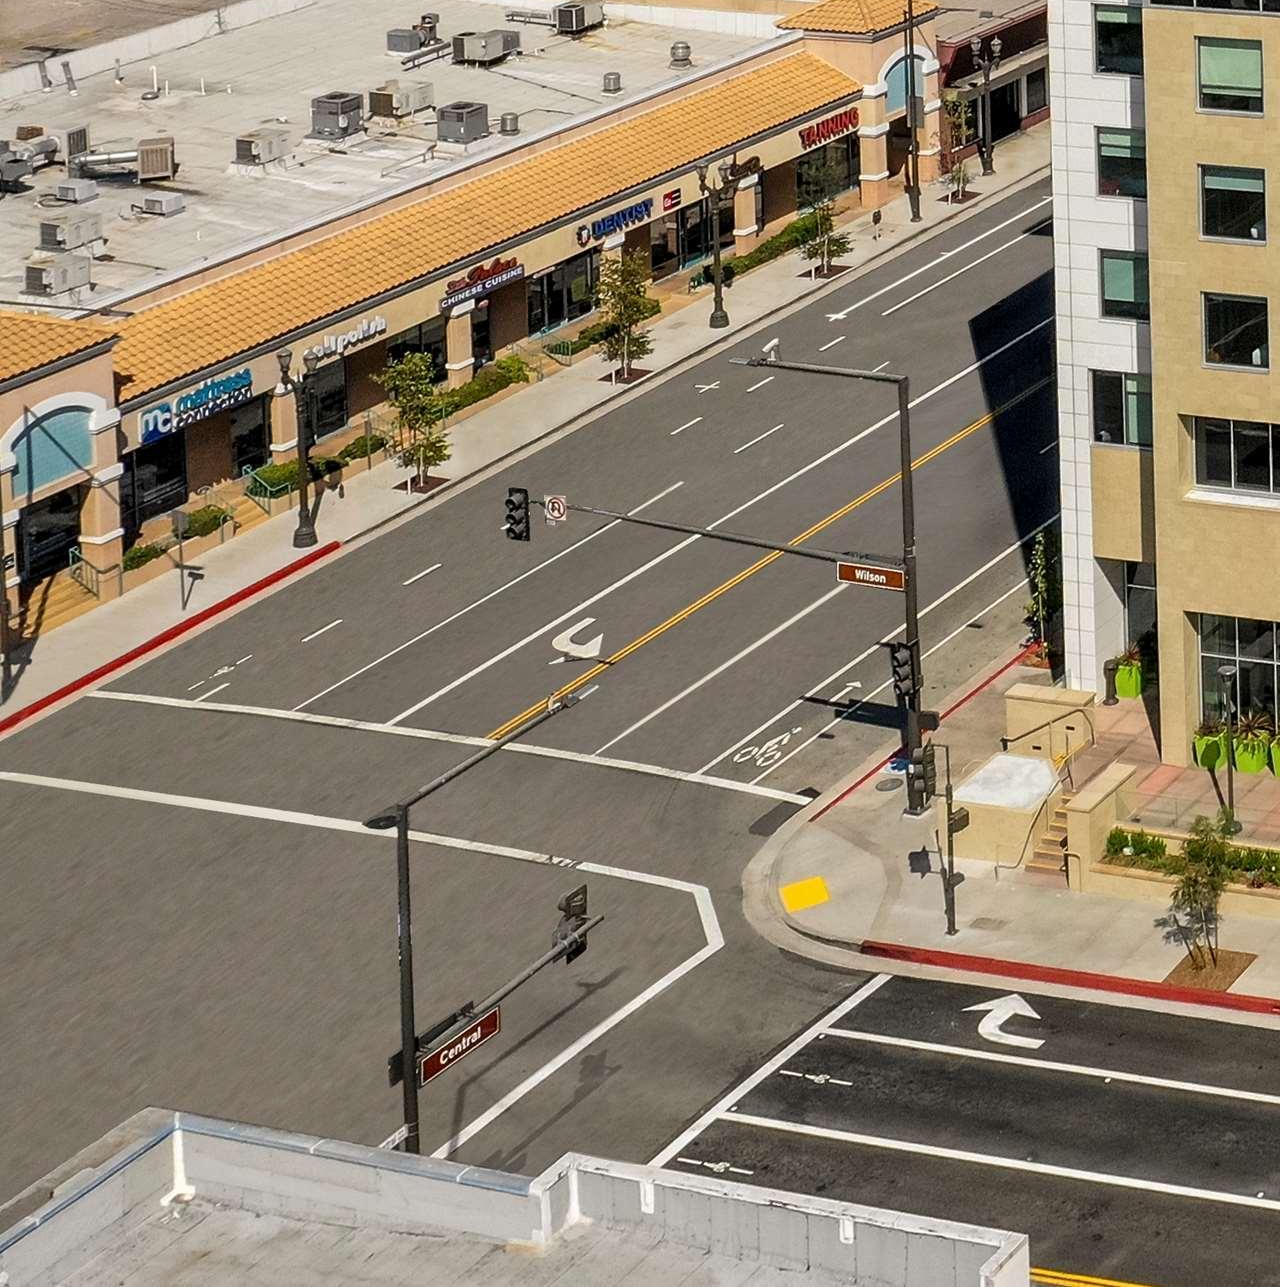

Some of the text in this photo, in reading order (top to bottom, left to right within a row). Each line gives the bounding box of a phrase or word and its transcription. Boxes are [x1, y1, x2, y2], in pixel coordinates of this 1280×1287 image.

[799, 107, 859, 150] TANNING
[593, 198, 653, 240] DENTIST
[441, 285, 483, 308] CHINESE
[485, 266, 523, 289] CUISINE
[337, 315, 386, 353] polish
[854, 569, 887, 583] Wilson
[439, 1027, 481, 1065] Central
